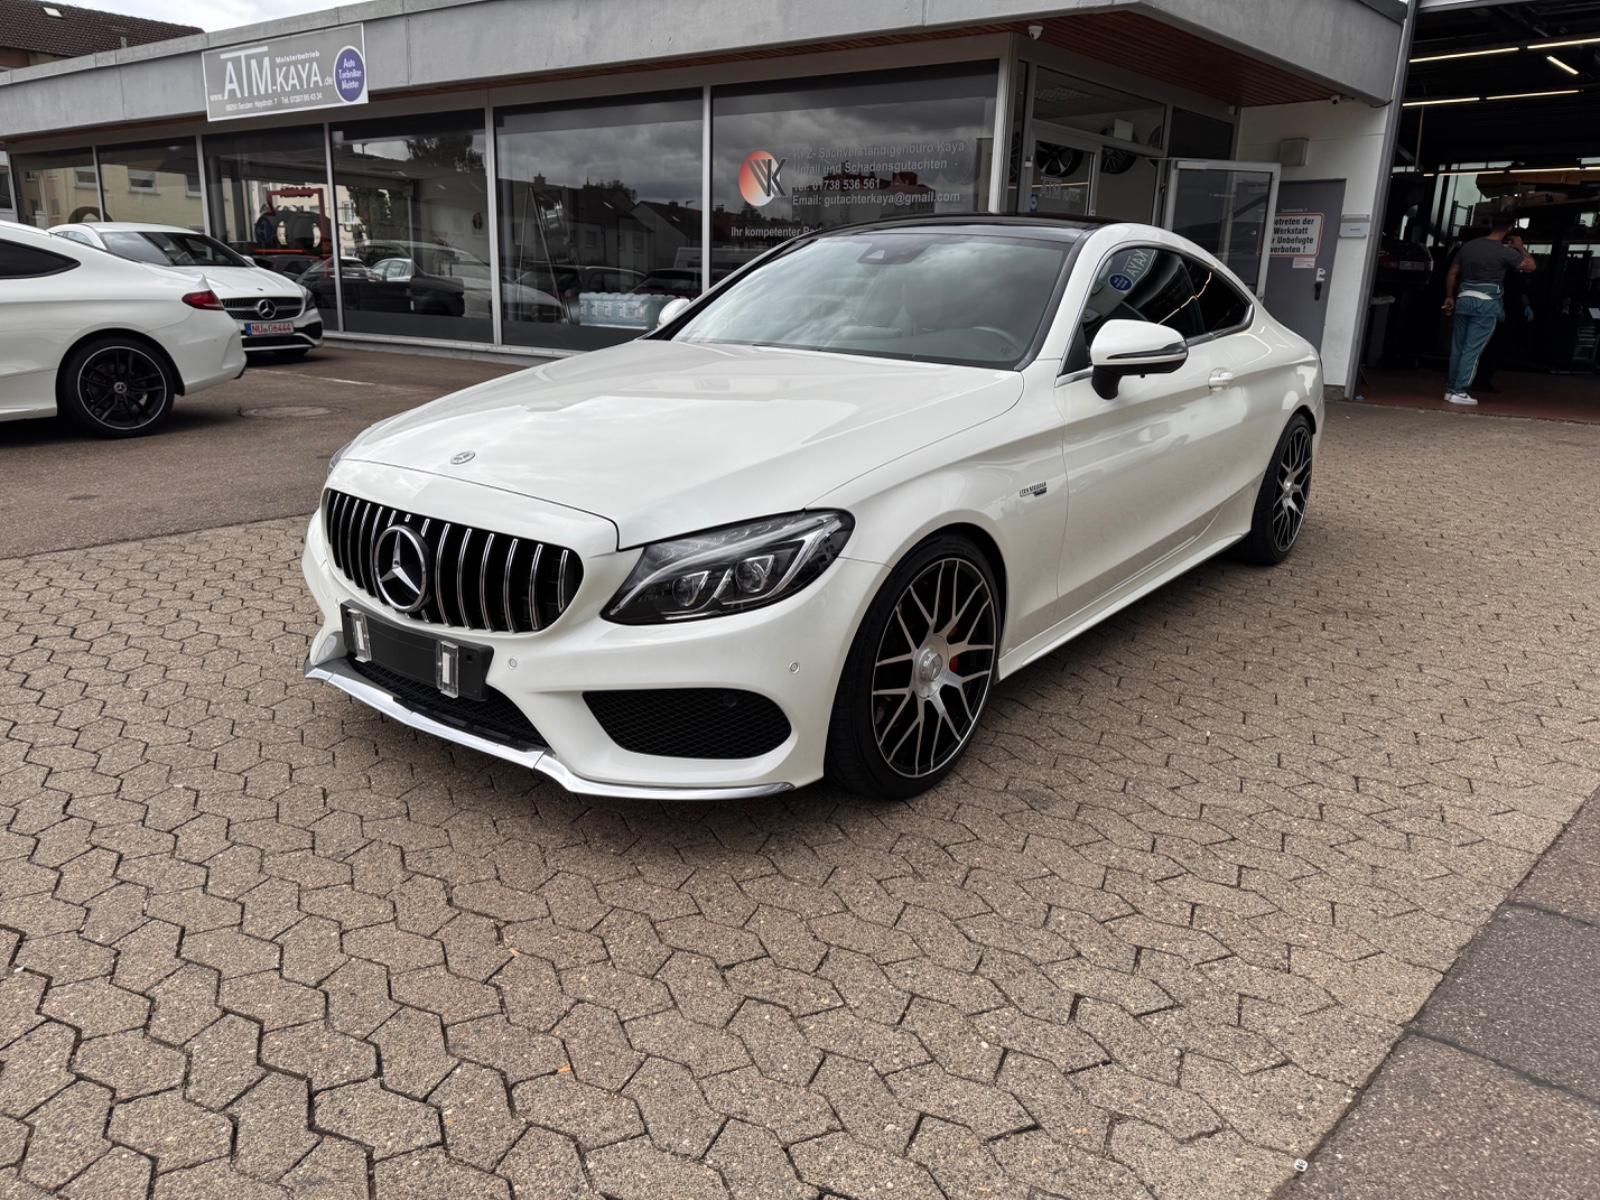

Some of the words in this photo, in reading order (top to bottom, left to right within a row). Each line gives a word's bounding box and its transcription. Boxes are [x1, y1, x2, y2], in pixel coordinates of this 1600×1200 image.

[843, 179, 860, 190] 536
[863, 178, 880, 189] 561
[792, 194, 821, 206] Email:
[731, 226, 742, 237] Ihr
[745, 226, 800, 238] kompetenter
[1277, 236, 1314, 244] Unbefugte
